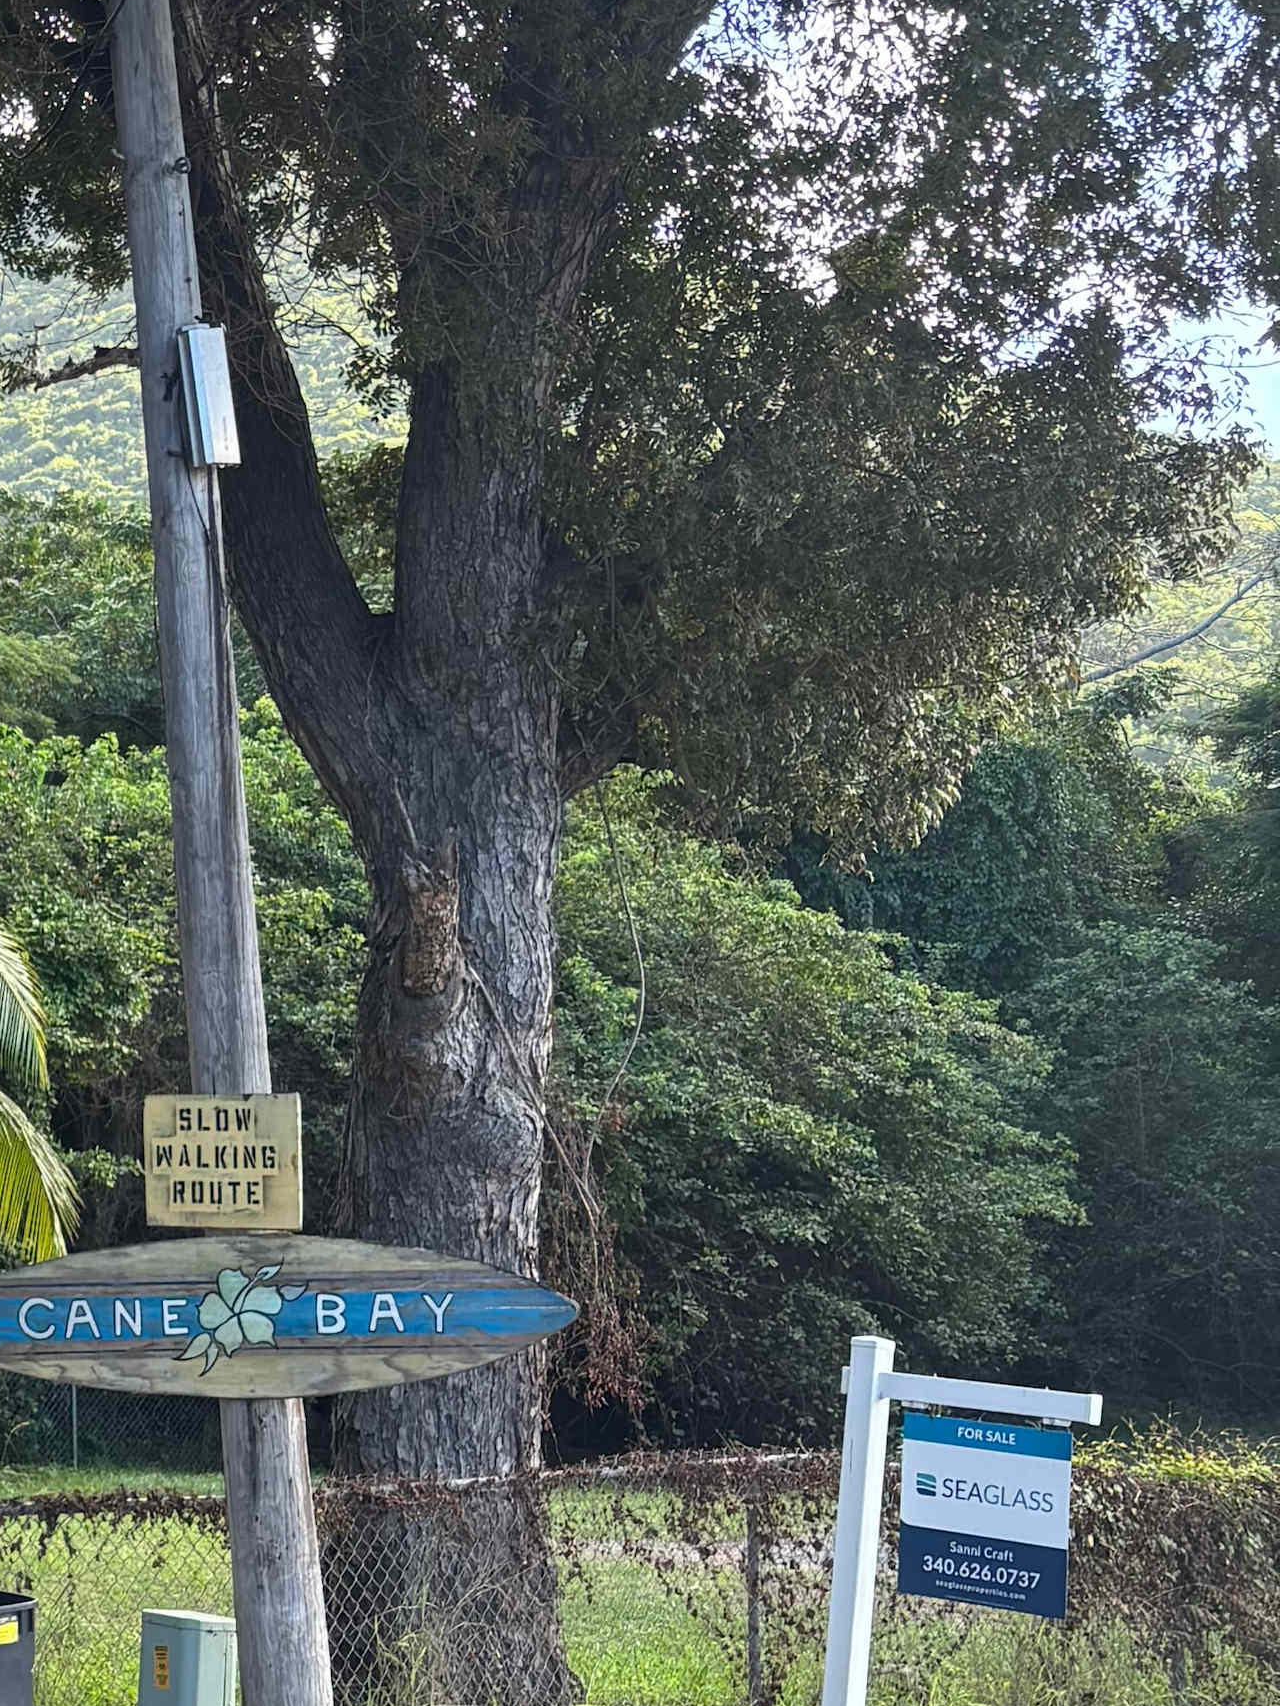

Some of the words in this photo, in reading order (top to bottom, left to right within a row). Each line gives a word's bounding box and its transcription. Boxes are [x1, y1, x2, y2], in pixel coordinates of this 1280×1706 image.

[178, 1108, 252, 1132] SLOW
[156, 1144, 277, 1170] WALKING
[172, 1180, 261, 1205] ROUTE
[17, 1296, 189, 1340] CANE
[315, 1292, 454, 1335] BAY
[957, 1426, 983, 1442] FOR
[985, 1429, 1017, 1445] SALE
[941, 1477, 1054, 1513] SEAGLASS
[983, 1546, 1014, 1563] Craft
[922, 1555, 1041, 1589] 340.626.0737
